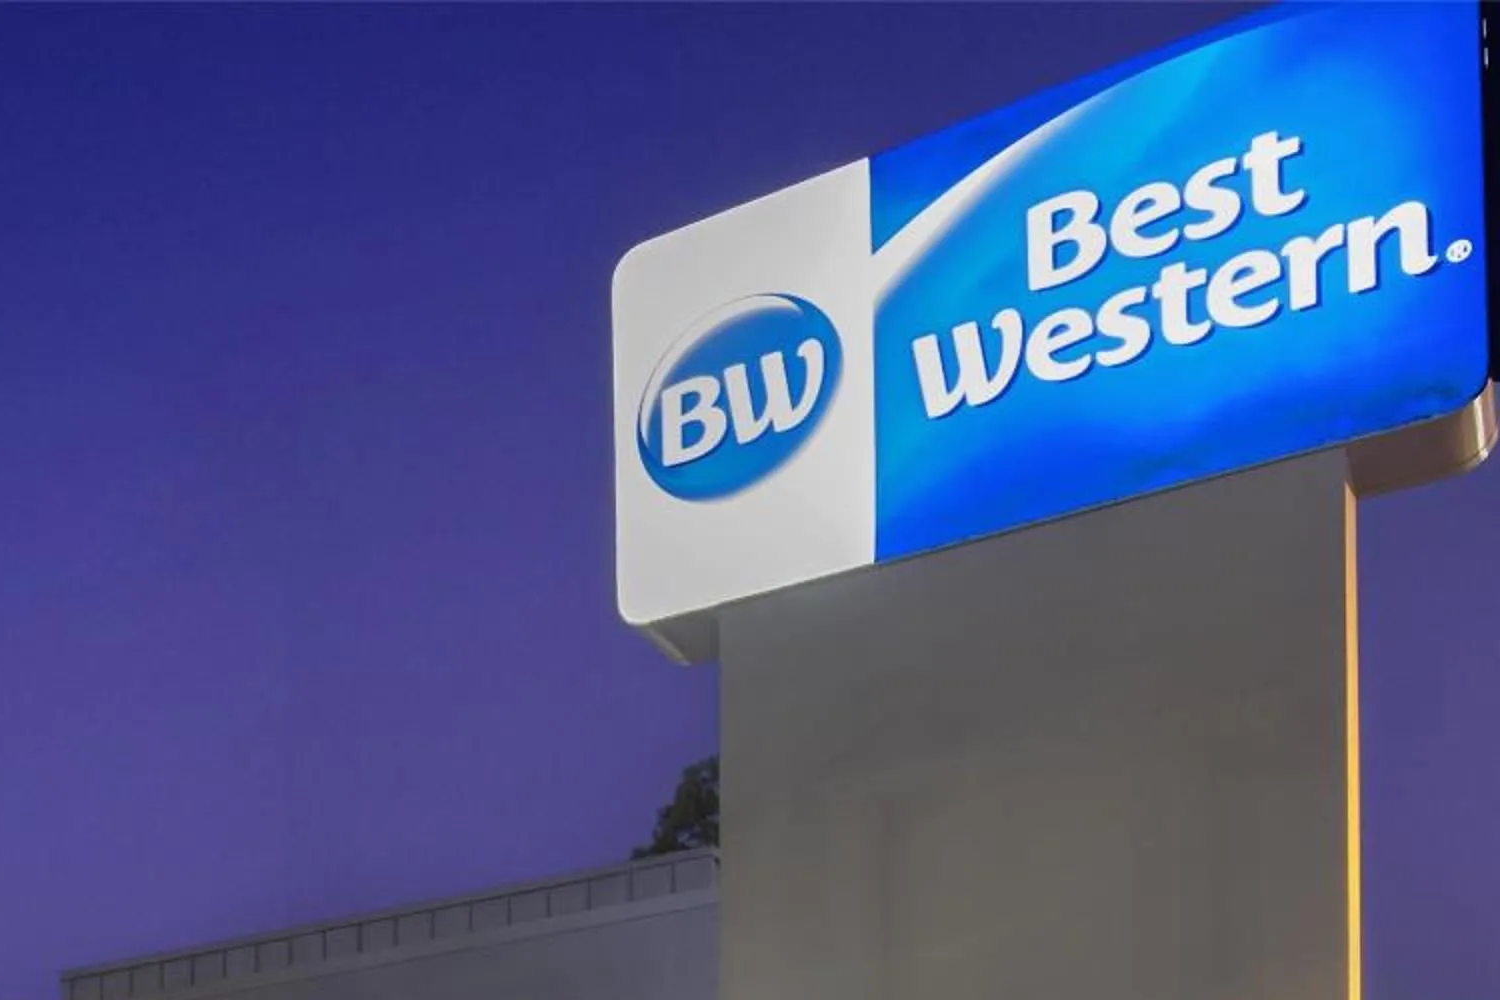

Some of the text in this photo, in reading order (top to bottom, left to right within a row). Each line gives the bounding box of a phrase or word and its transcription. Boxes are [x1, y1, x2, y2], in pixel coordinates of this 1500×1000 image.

[1027, 131, 1306, 291] Best
[913, 201, 1439, 418] Western
[661, 339, 824, 467] BW
